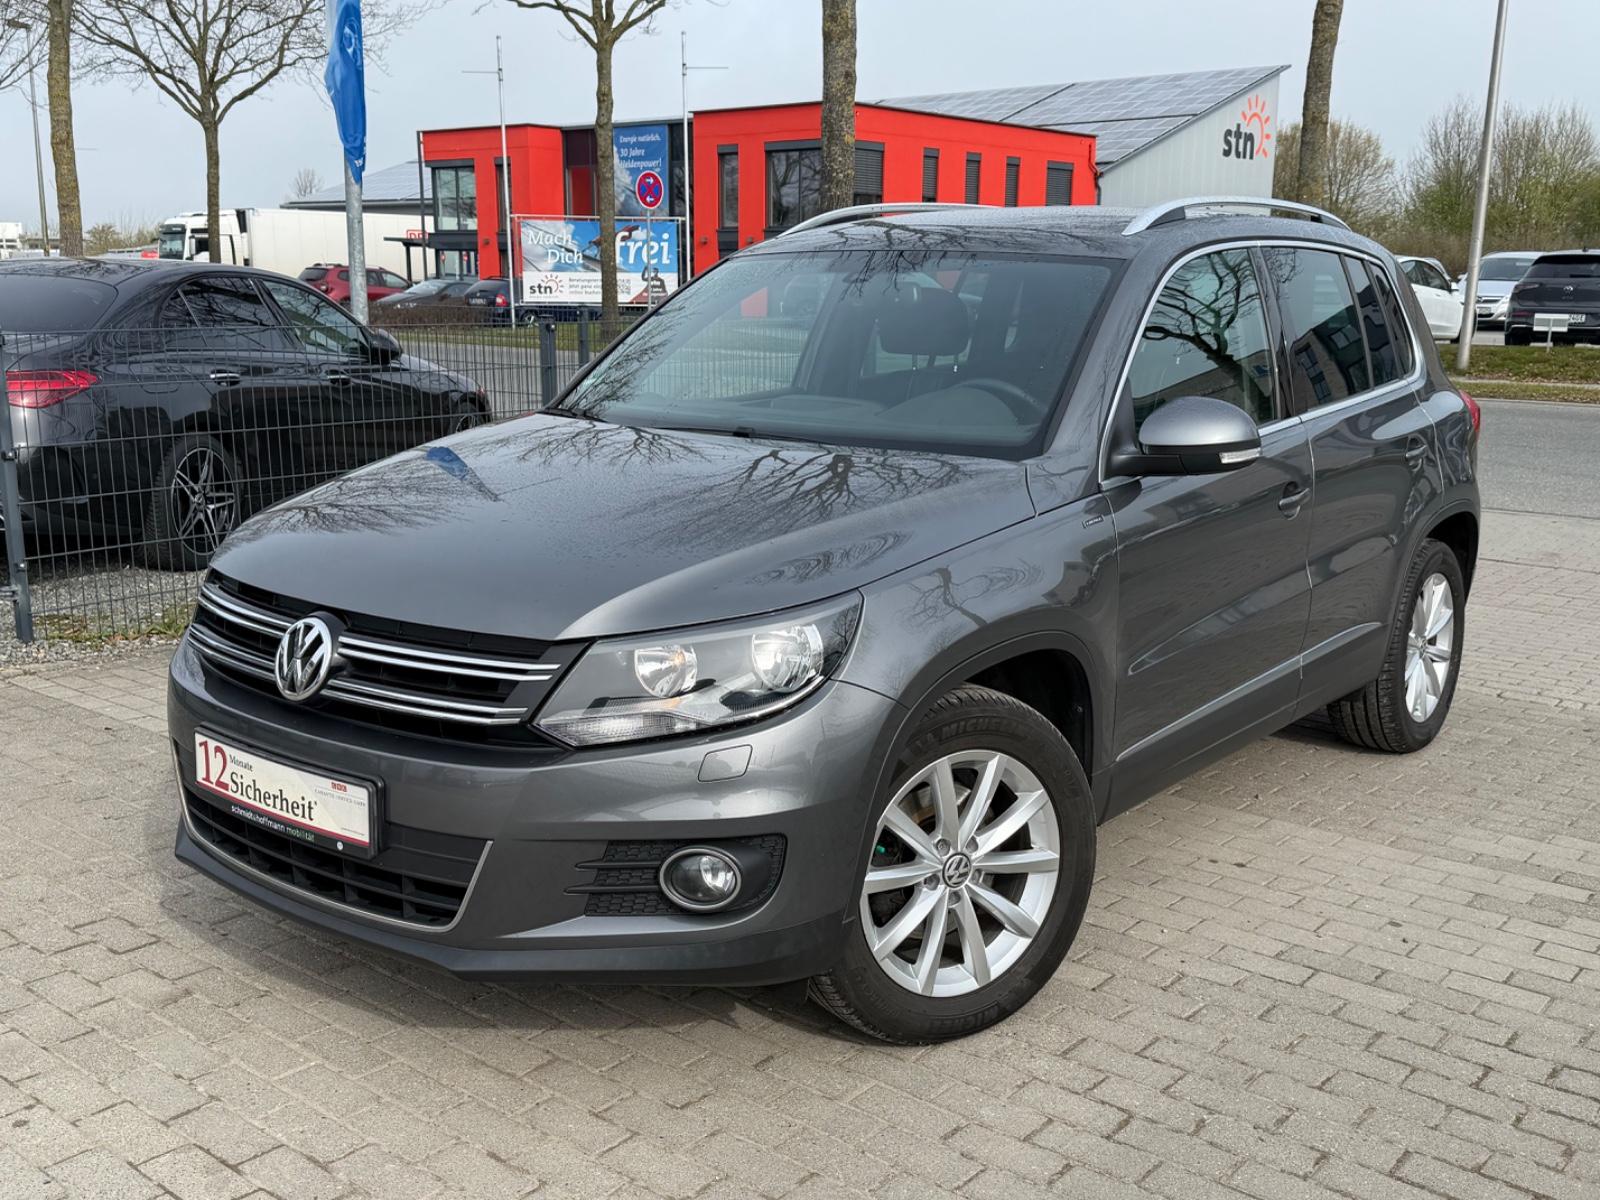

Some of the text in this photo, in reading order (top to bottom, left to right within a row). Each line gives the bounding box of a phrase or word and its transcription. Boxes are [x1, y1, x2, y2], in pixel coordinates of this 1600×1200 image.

[1222, 123, 1255, 160] stn
[620, 147, 645, 157] 30 Jahre
[528, 230, 576, 246] Mach
[547, 248, 583, 264] Dich
[615, 231, 671, 265] frei
[529, 283, 553, 295] stn
[198, 740, 229, 792] 12
[229, 754, 253, 772] Monate
